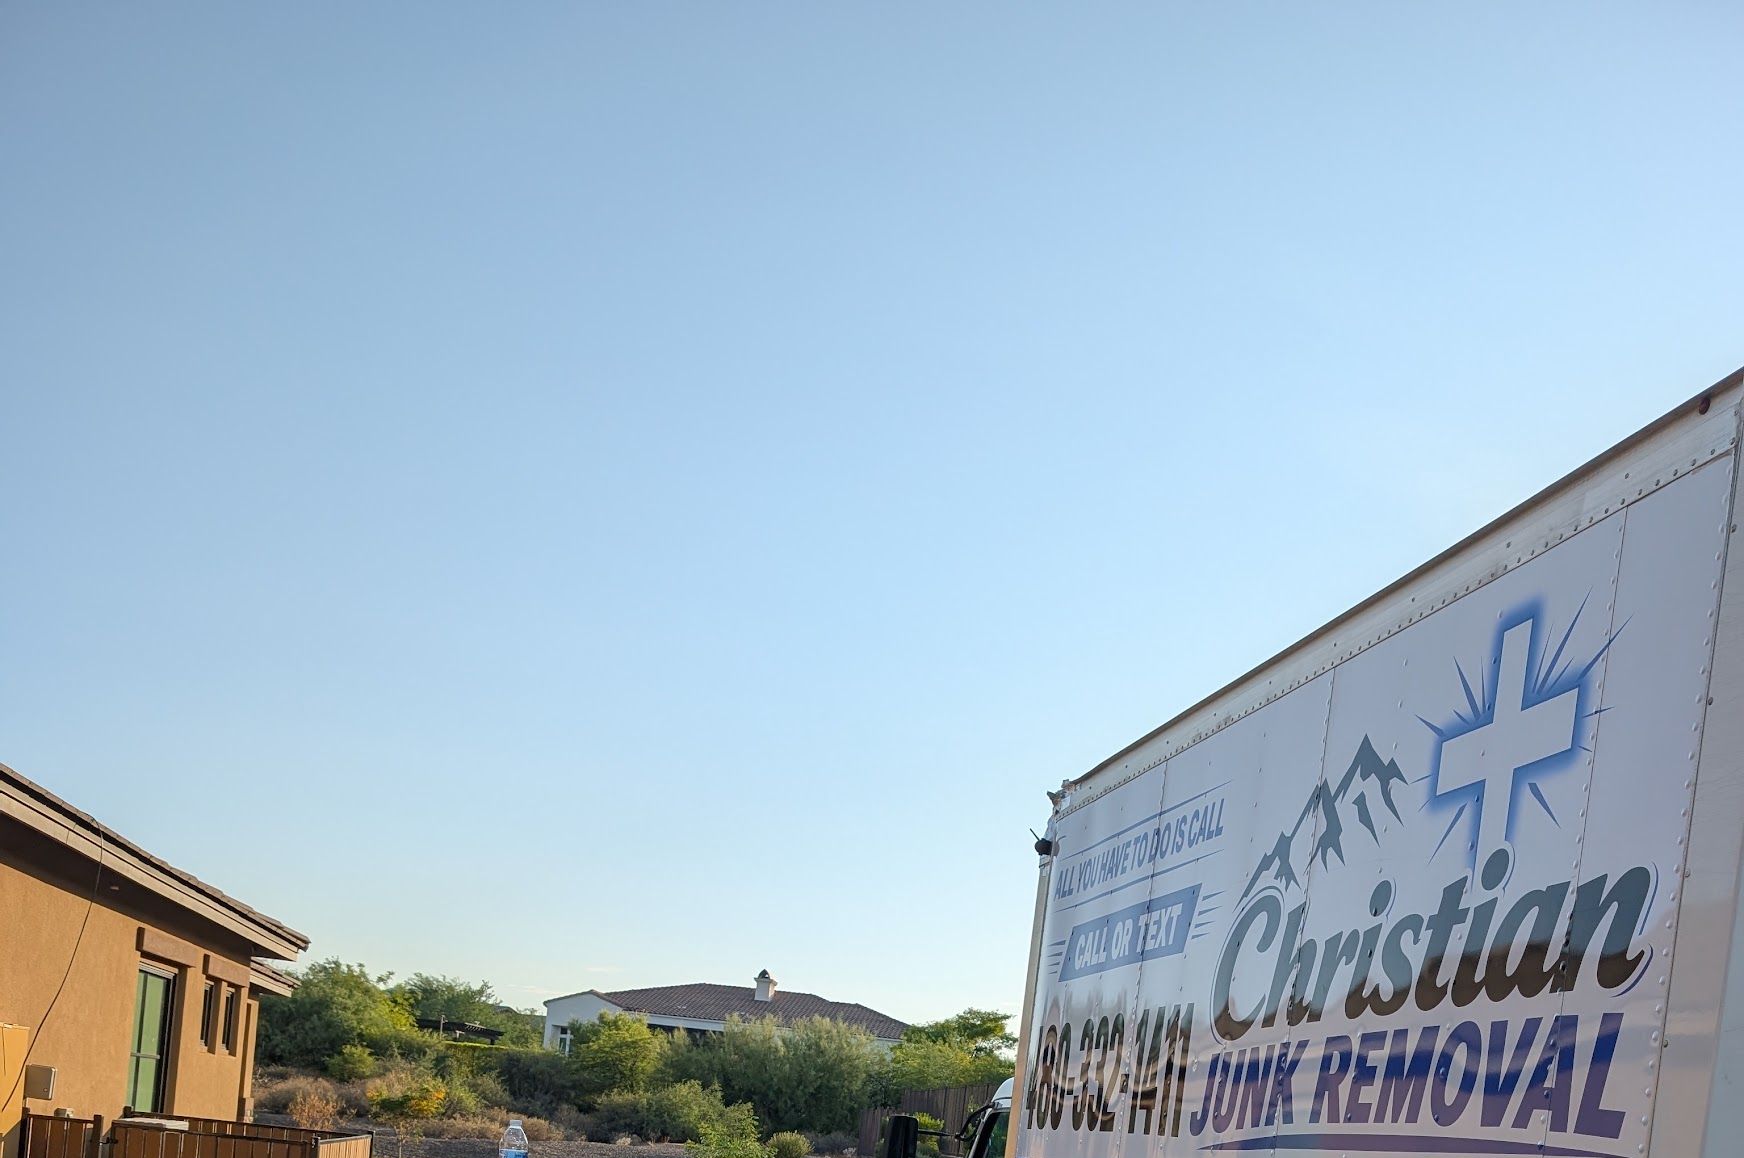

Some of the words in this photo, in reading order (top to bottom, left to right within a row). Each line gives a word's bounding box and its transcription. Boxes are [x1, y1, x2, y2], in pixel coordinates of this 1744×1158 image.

[1054, 866, 1074, 900] ALL
[1077, 855, 1100, 893] YOU
[1100, 840, 1131, 882] HAVE
[1131, 832, 1148, 870] TO
[1148, 823, 1171, 863] DO
[1171, 815, 1187, 855] IS
[1187, 799, 1224, 848] CALL
[1074, 927, 1107, 970] CALL
[1112, 918, 1133, 960] OR
[1136, 903, 1183, 953] TEXT
[1211, 848, 1655, 1042] Christian
[1026, 1003, 1194, 1137] 480-332-1411
[1189, 1039, 1309, 1136] JUNK
[1309, 1012, 1626, 1139] REMOVAL
